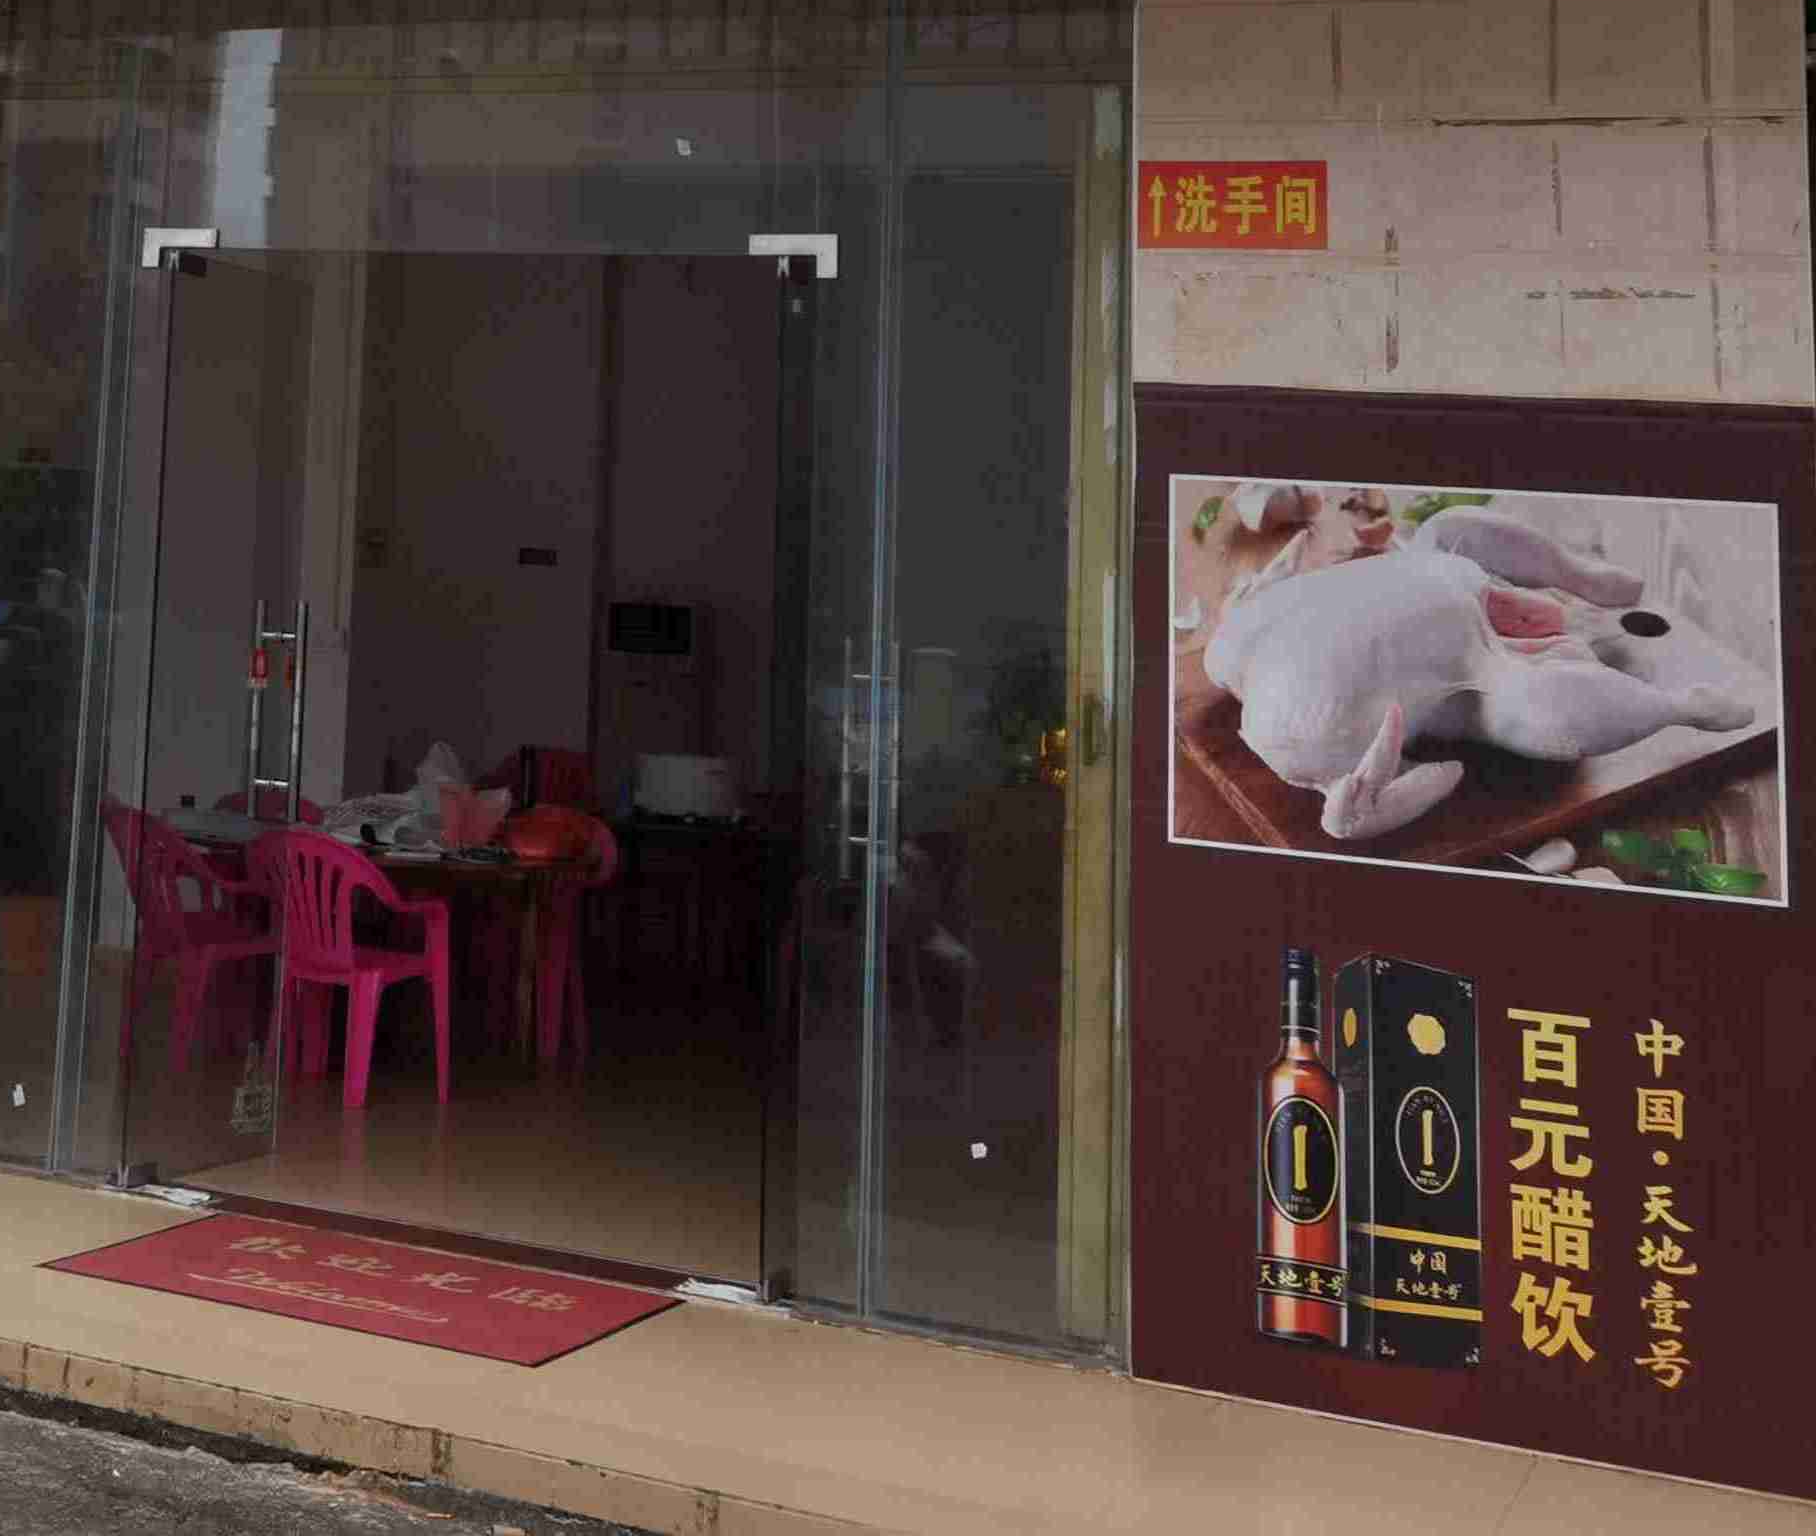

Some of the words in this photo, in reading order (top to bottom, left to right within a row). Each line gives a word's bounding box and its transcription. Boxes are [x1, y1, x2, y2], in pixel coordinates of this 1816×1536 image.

[1174, 173, 1318, 235] 洗手间
[1506, 1007, 1596, 1363] 百元醋饮
